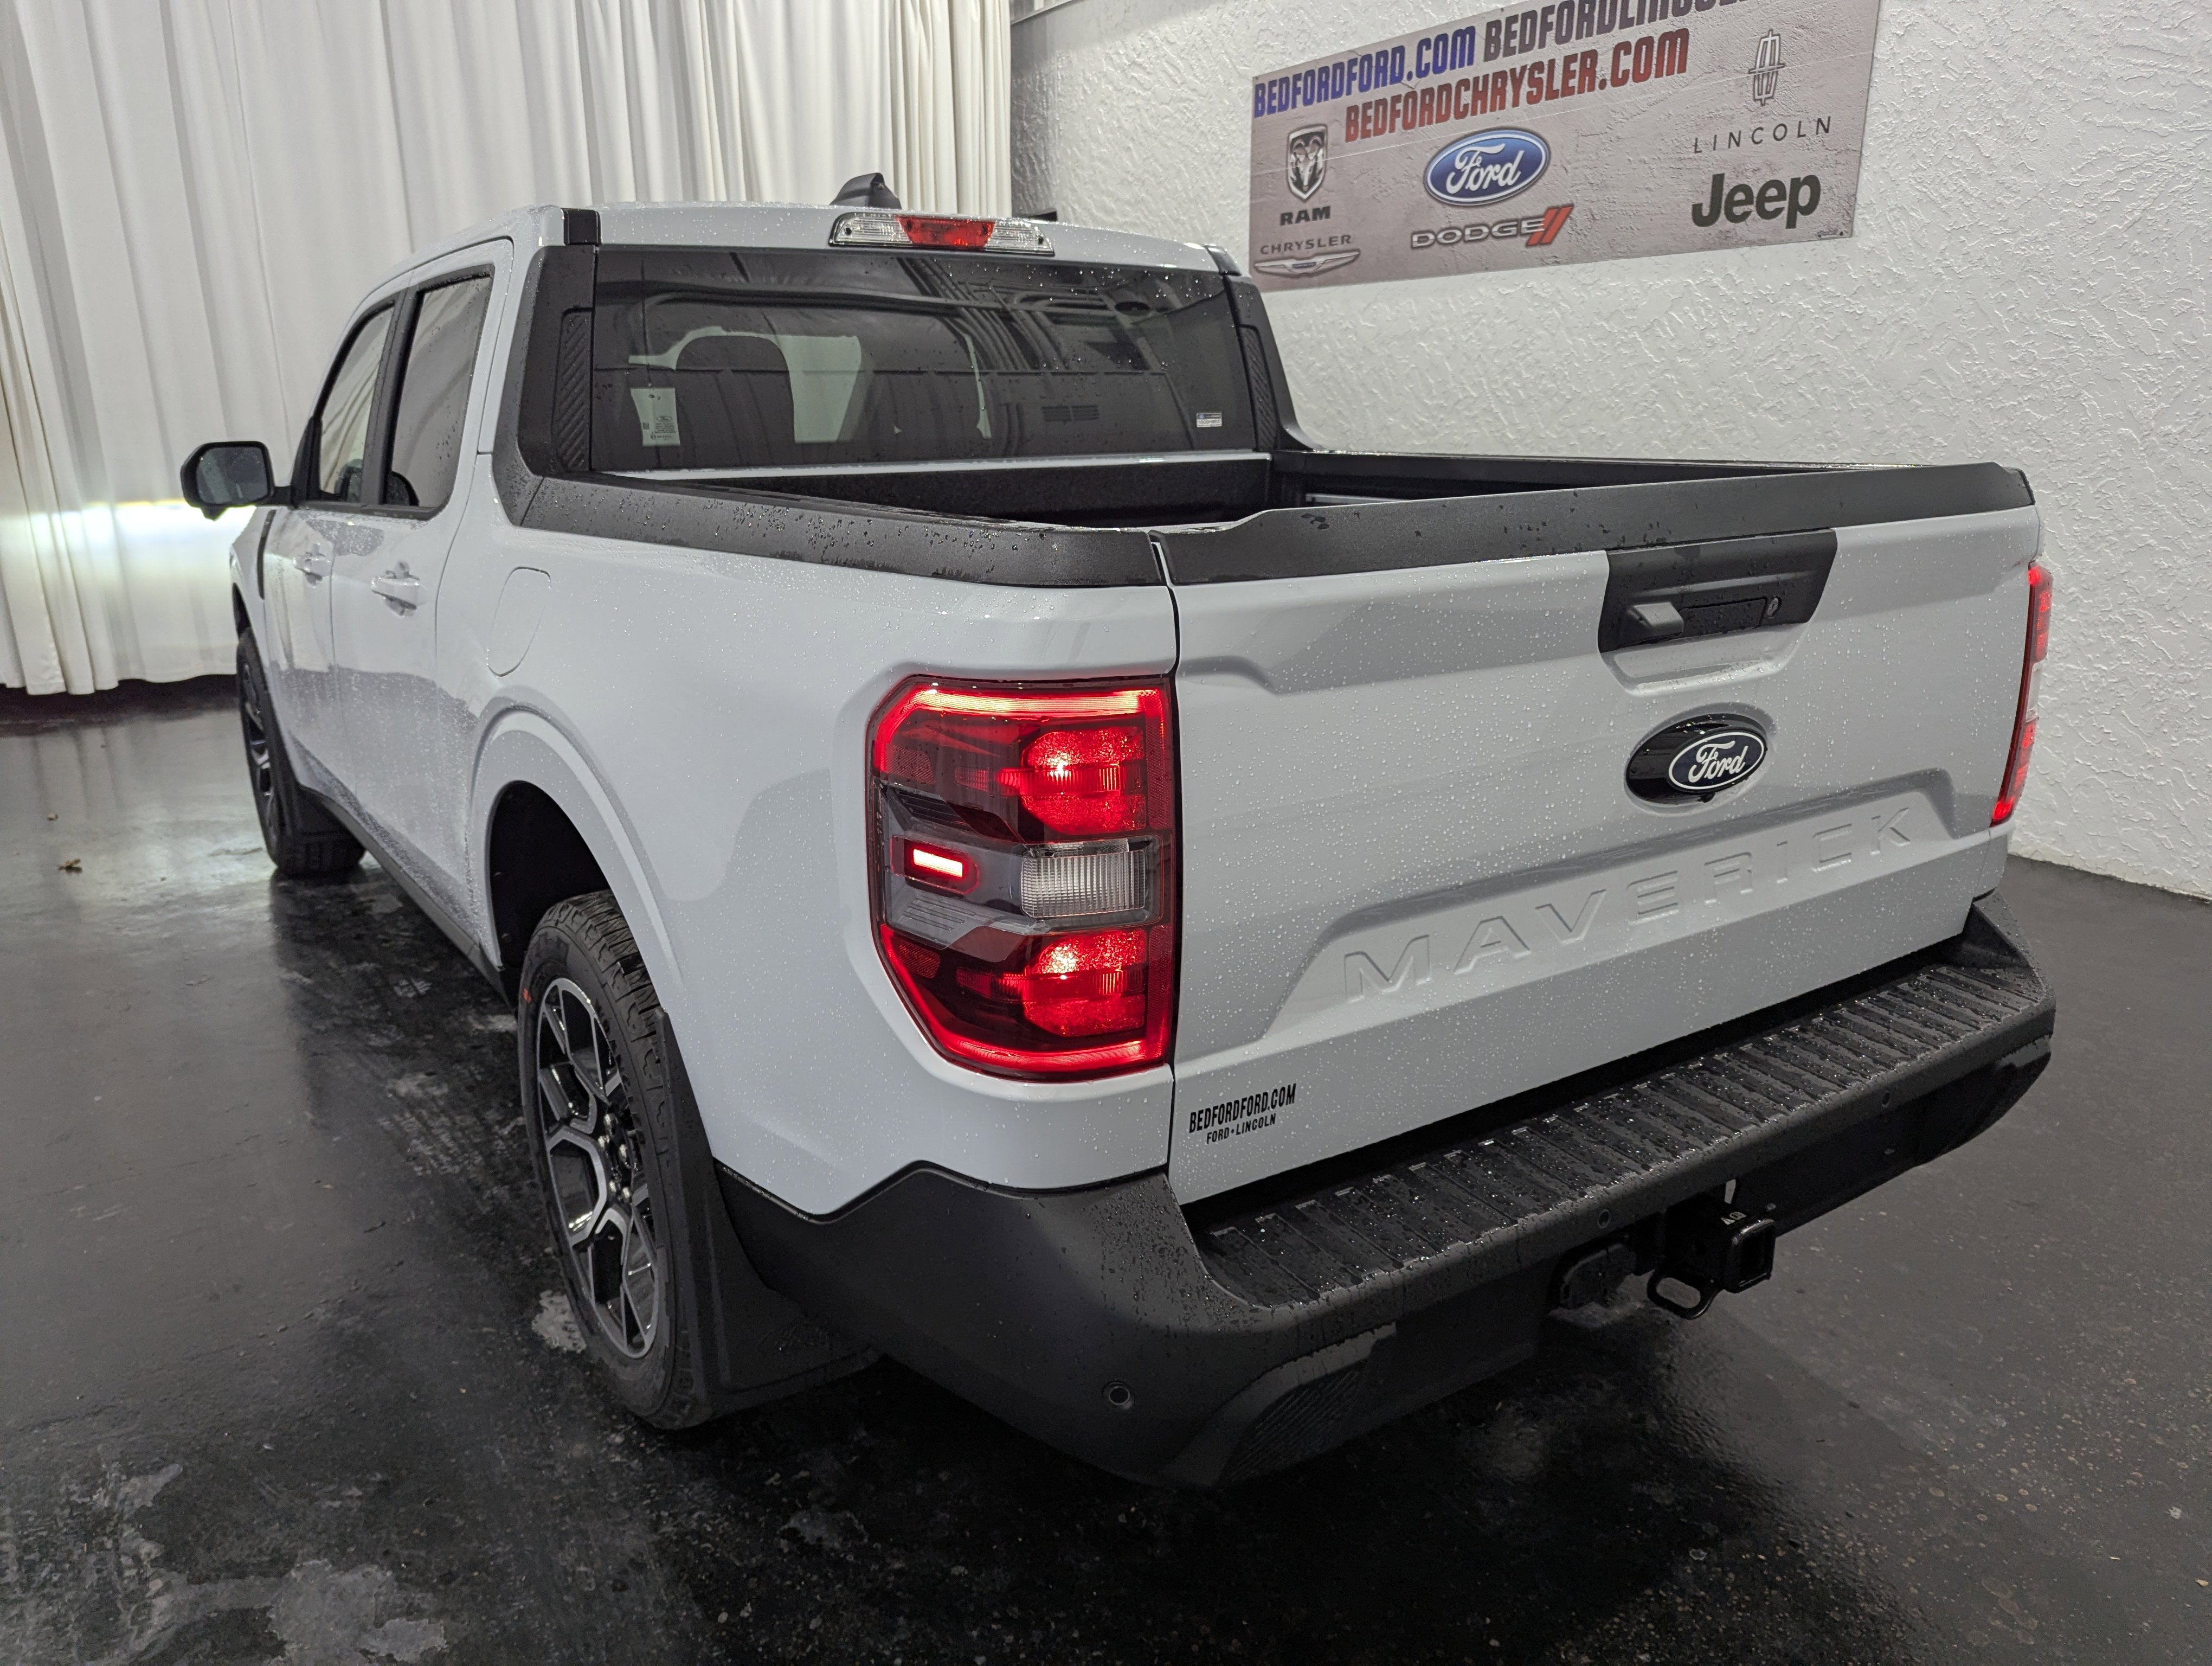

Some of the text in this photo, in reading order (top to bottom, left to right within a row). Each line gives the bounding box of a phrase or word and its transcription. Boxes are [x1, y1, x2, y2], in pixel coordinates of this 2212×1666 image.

[1254, 26, 1476, 118] BEDFORDFORD.COM
[1345, 28, 1689, 143] BEDFORDCHRYSLER.COM
[1694, 116, 1831, 153] LINCOLN
[1445, 143, 1525, 194] Ford
[1279, 206, 1331, 226] RAM
[1691, 172, 1821, 229] Jeep
[1260, 234, 1352, 255] CHRYSLER
[1411, 216, 1546, 249] DODGE
[1688, 740, 1749, 783] Ford
[1343, 807, 1912, 1004] MAVERICK
[1189, 1083, 1296, 1133] BEDFORDFORD.COM
